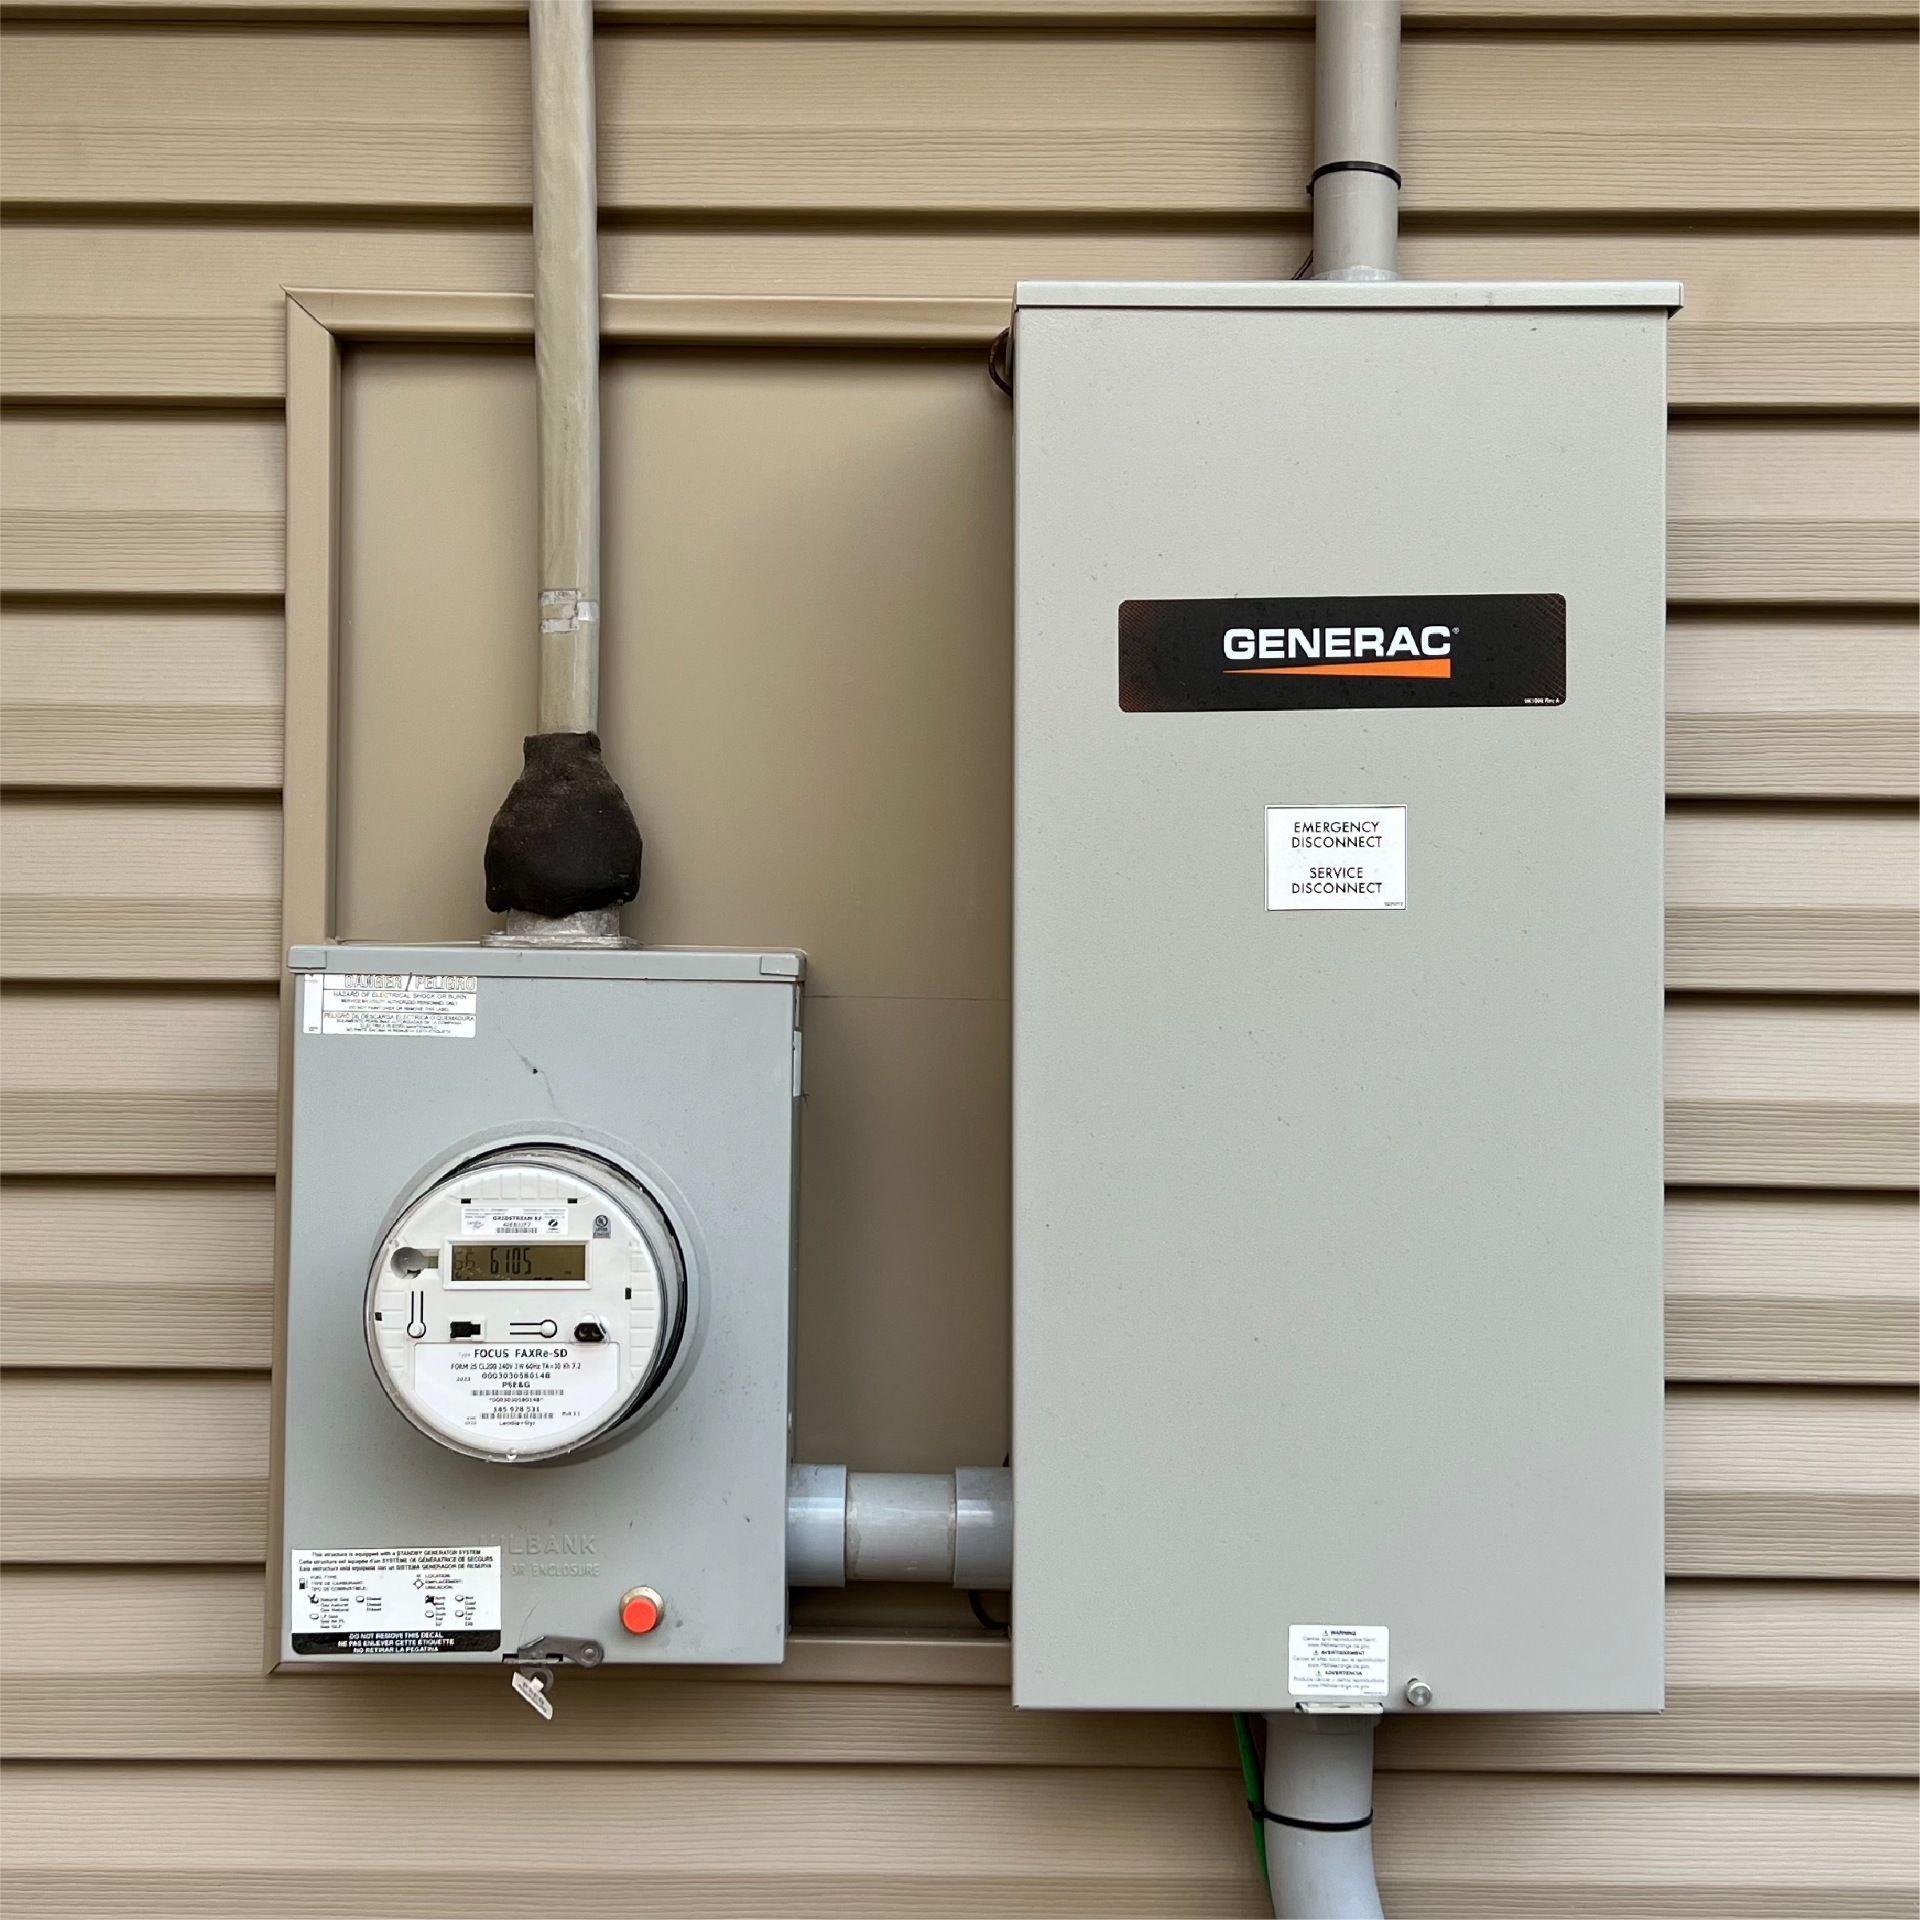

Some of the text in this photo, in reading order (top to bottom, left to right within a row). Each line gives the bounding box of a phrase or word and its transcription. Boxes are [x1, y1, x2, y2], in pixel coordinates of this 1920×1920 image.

[1223, 626, 1450, 659] GENERAC
[1294, 821, 1380, 833] EMERGENCY
[1291, 836, 1382, 848] DISCONNECT
[1309, 867, 1364, 879] SERVICE
[1291, 882, 1382, 894] DISCONNECT
[490, 1247, 531, 1275] 6105
[474, 1349, 510, 1358] FOCUS
[515, 1348, 568, 1358] FAXRe-SD
